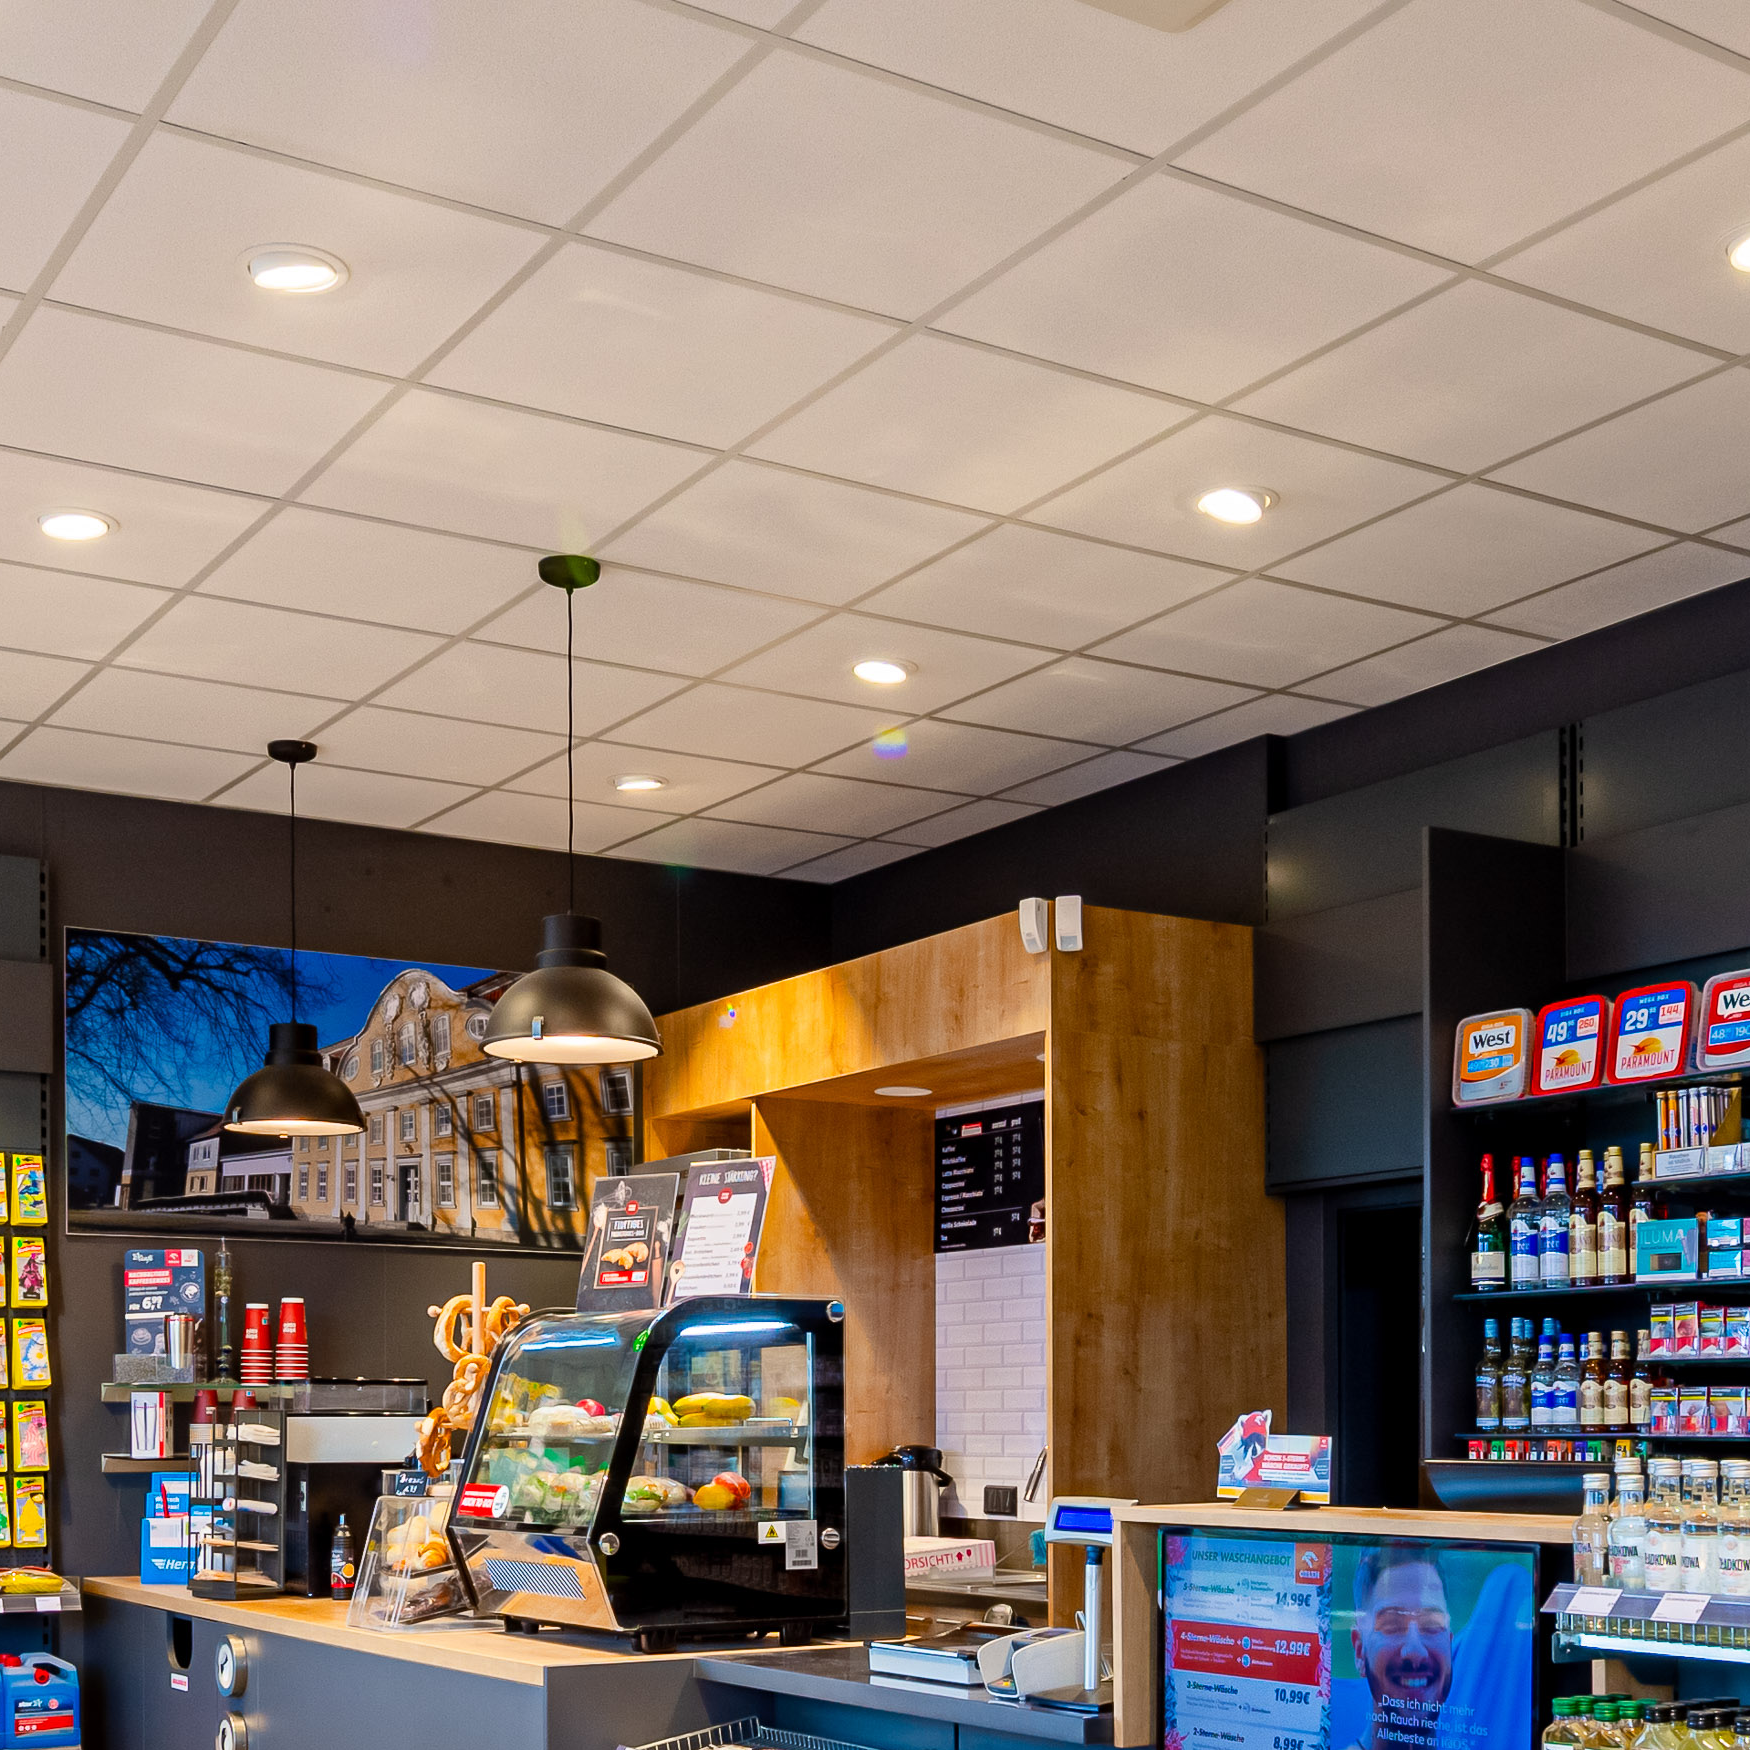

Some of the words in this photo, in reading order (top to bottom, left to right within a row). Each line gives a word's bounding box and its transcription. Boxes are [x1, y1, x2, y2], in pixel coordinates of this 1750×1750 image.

[1473, 1030, 1510, 1049] West
[1621, 1050, 1674, 1070] PARAMOUNT
[1545, 1061, 1592, 1082] PARAMOUNT
[1192, 1551, 1218, 1561] UNSER
[1220, 1552, 1290, 1566] WASCHANGEBOT
[1275, 1593, 1311, 1607] 14,99€
[1275, 1640, 1311, 1656] 12,99€
[1275, 1688, 1310, 1704] 10,99€
[1407, 1698, 1419, 1709] ich
[1422, 1700, 1446, 1713] nicht
[1390, 1714, 1419, 1727] Rauch
[1470, 1724, 1488, 1736] das
[1377, 1728, 1424, 1744] Allerbeste
[1427, 1737, 1438, 1746] an
